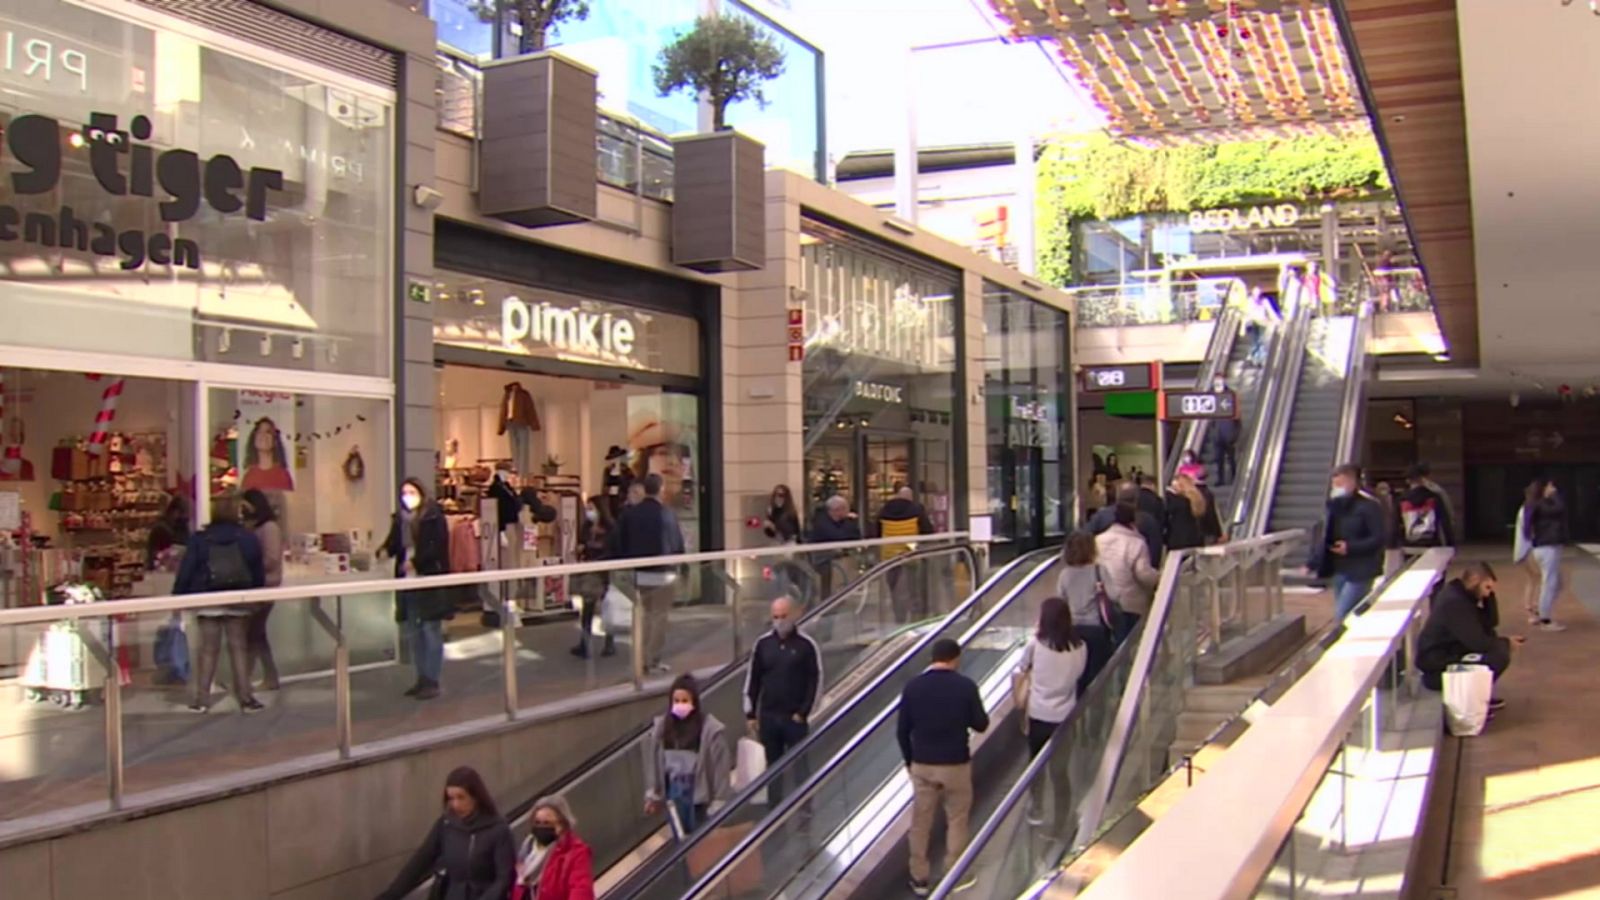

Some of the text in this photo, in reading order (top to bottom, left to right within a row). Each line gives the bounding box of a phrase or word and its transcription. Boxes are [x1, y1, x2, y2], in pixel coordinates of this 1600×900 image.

[82, 111, 284, 222] tiger
[1189, 203, 1299, 234] BEDLAND
[501, 296, 635, 355] pimkie
